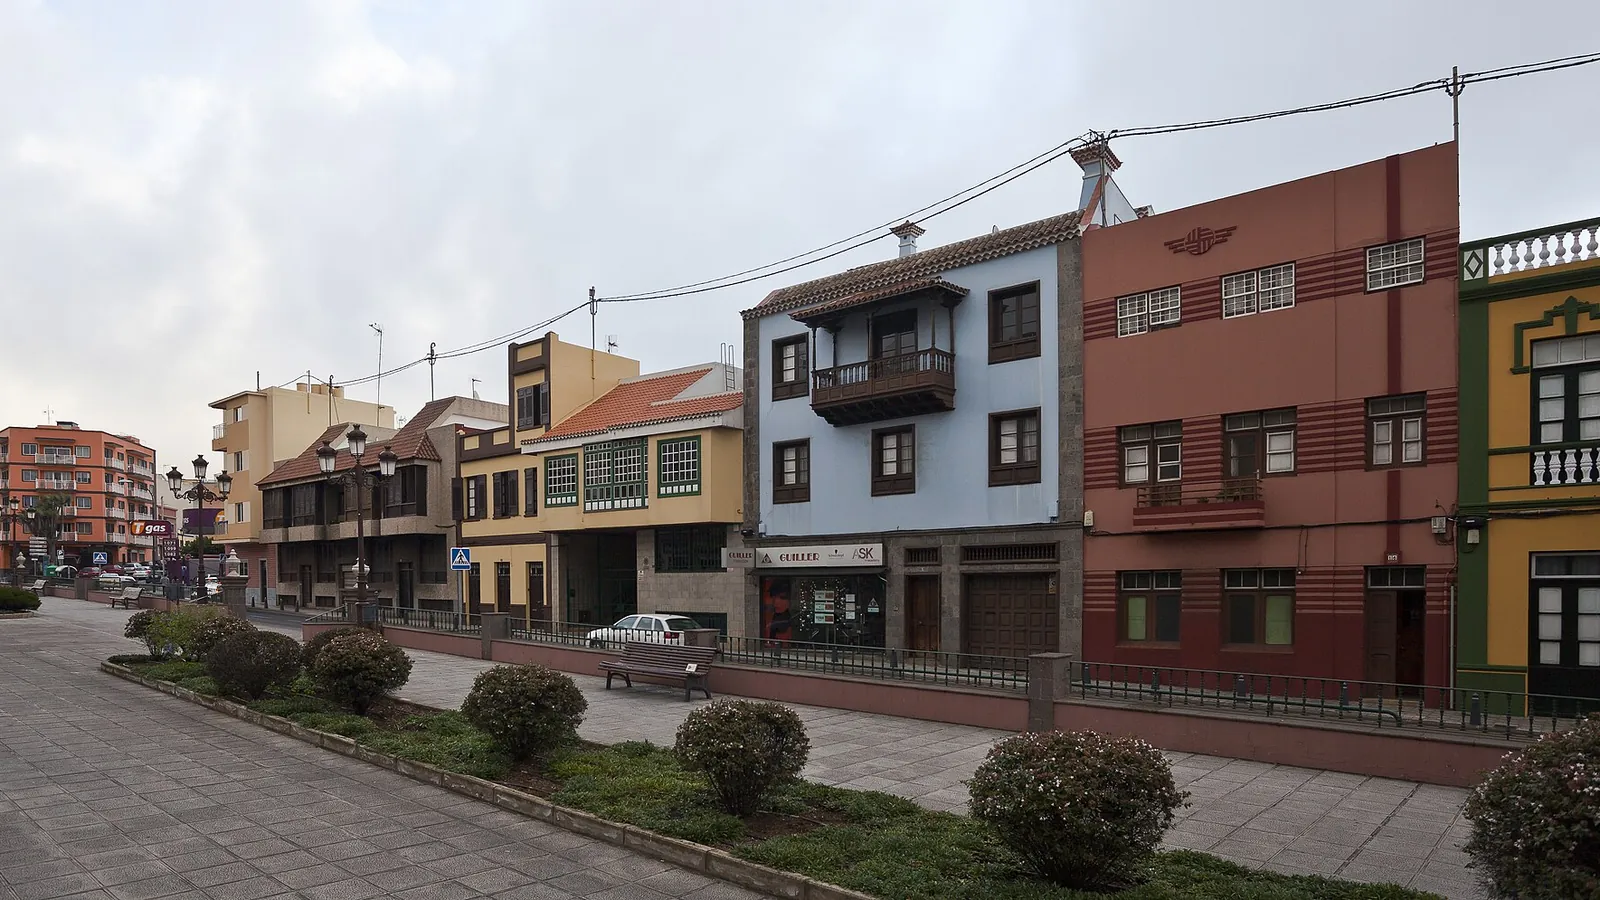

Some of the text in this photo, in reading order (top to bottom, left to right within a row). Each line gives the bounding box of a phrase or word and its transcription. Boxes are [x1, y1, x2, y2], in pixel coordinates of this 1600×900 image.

[145, 525, 166, 534] gas
[779, 552, 820, 562] GUILLER
[852, 547, 874, 560] ASK
